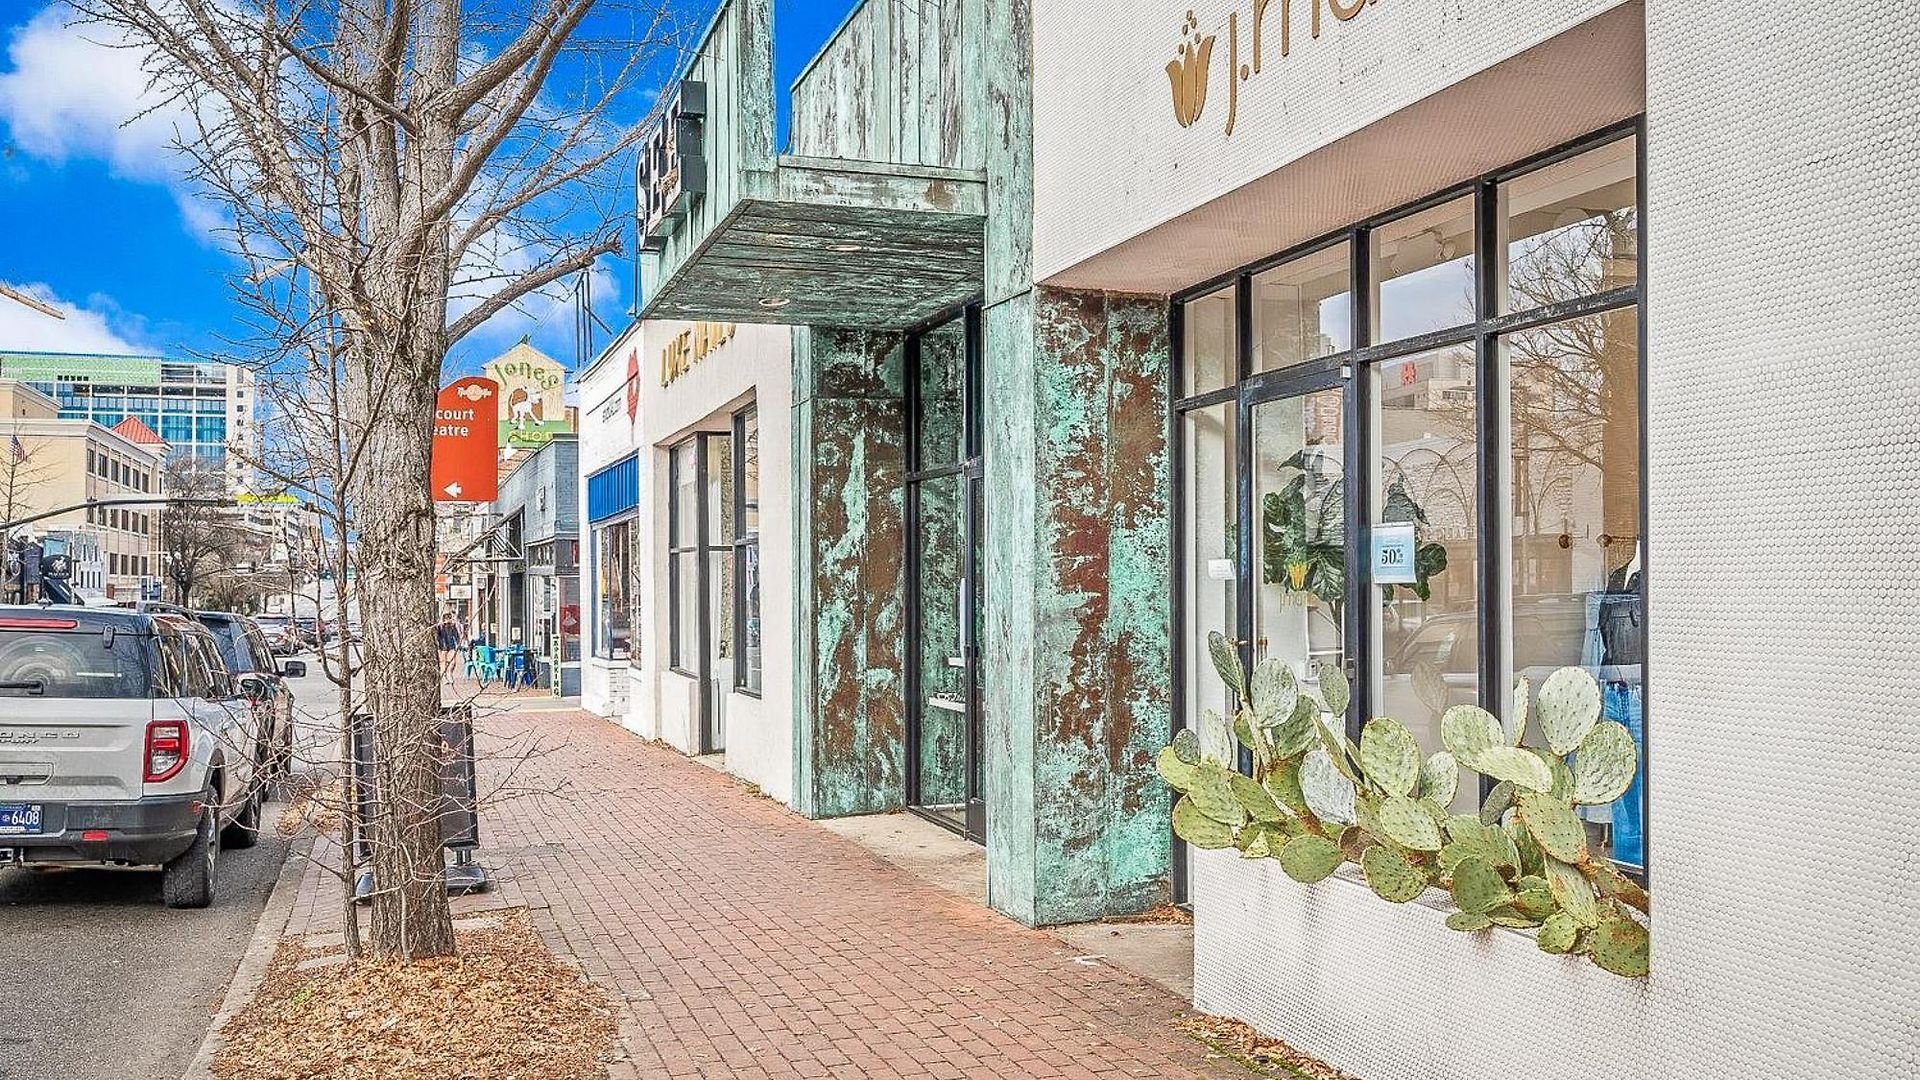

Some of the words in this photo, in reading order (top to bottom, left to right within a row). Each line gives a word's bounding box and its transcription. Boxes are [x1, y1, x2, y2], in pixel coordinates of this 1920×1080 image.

[636, 82, 685, 252] SEE
[493, 361, 559, 391] Jones
[435, 408, 475, 421] court
[433, 424, 469, 437] eatre
[12, 810, 40, 825] 6408
